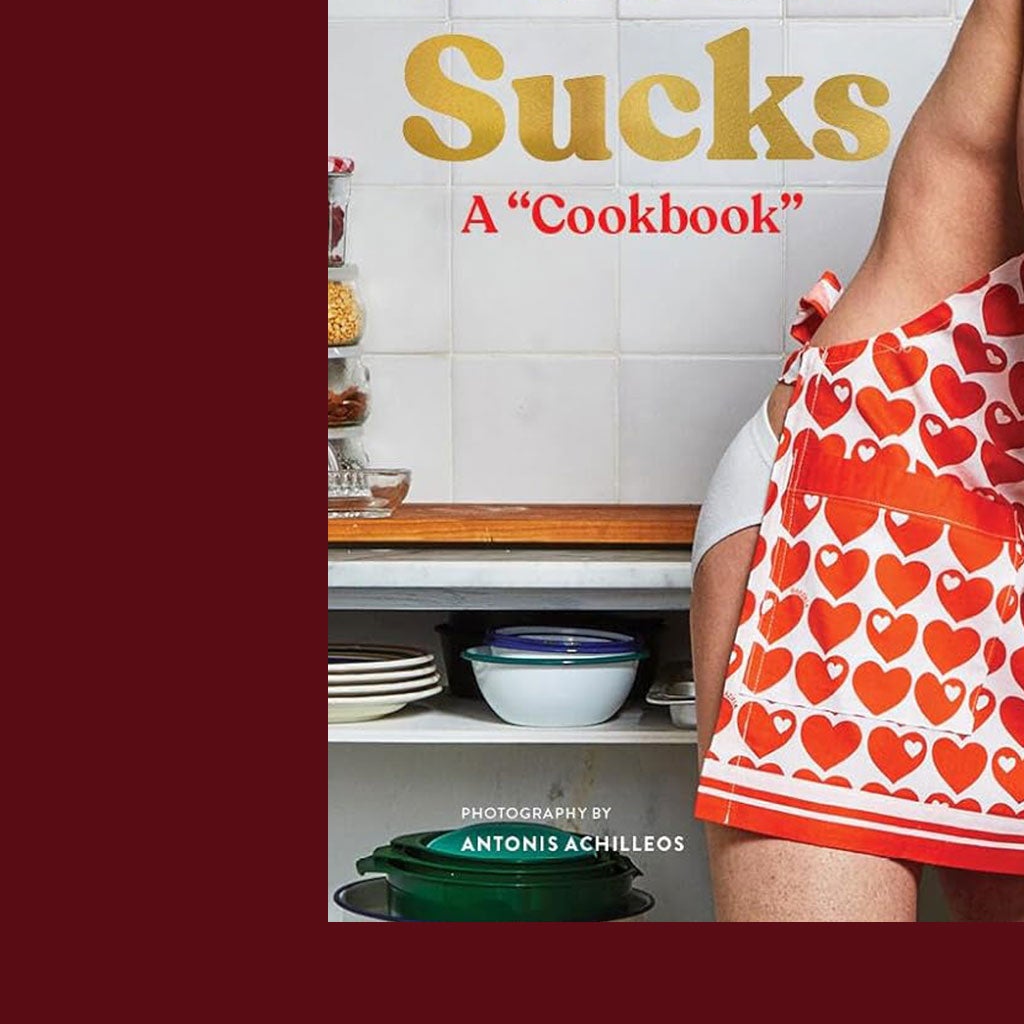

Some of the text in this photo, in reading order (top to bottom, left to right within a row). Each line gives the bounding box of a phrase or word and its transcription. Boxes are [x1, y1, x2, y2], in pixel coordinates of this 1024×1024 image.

[402, 27, 891, 163] Sucks
[461, 191, 803, 235] A “Cookbook”
[461, 805, 612, 821] PHOTOGRAPHY BY
[461, 834, 685, 853] ANTONIS ACHILLEOS
